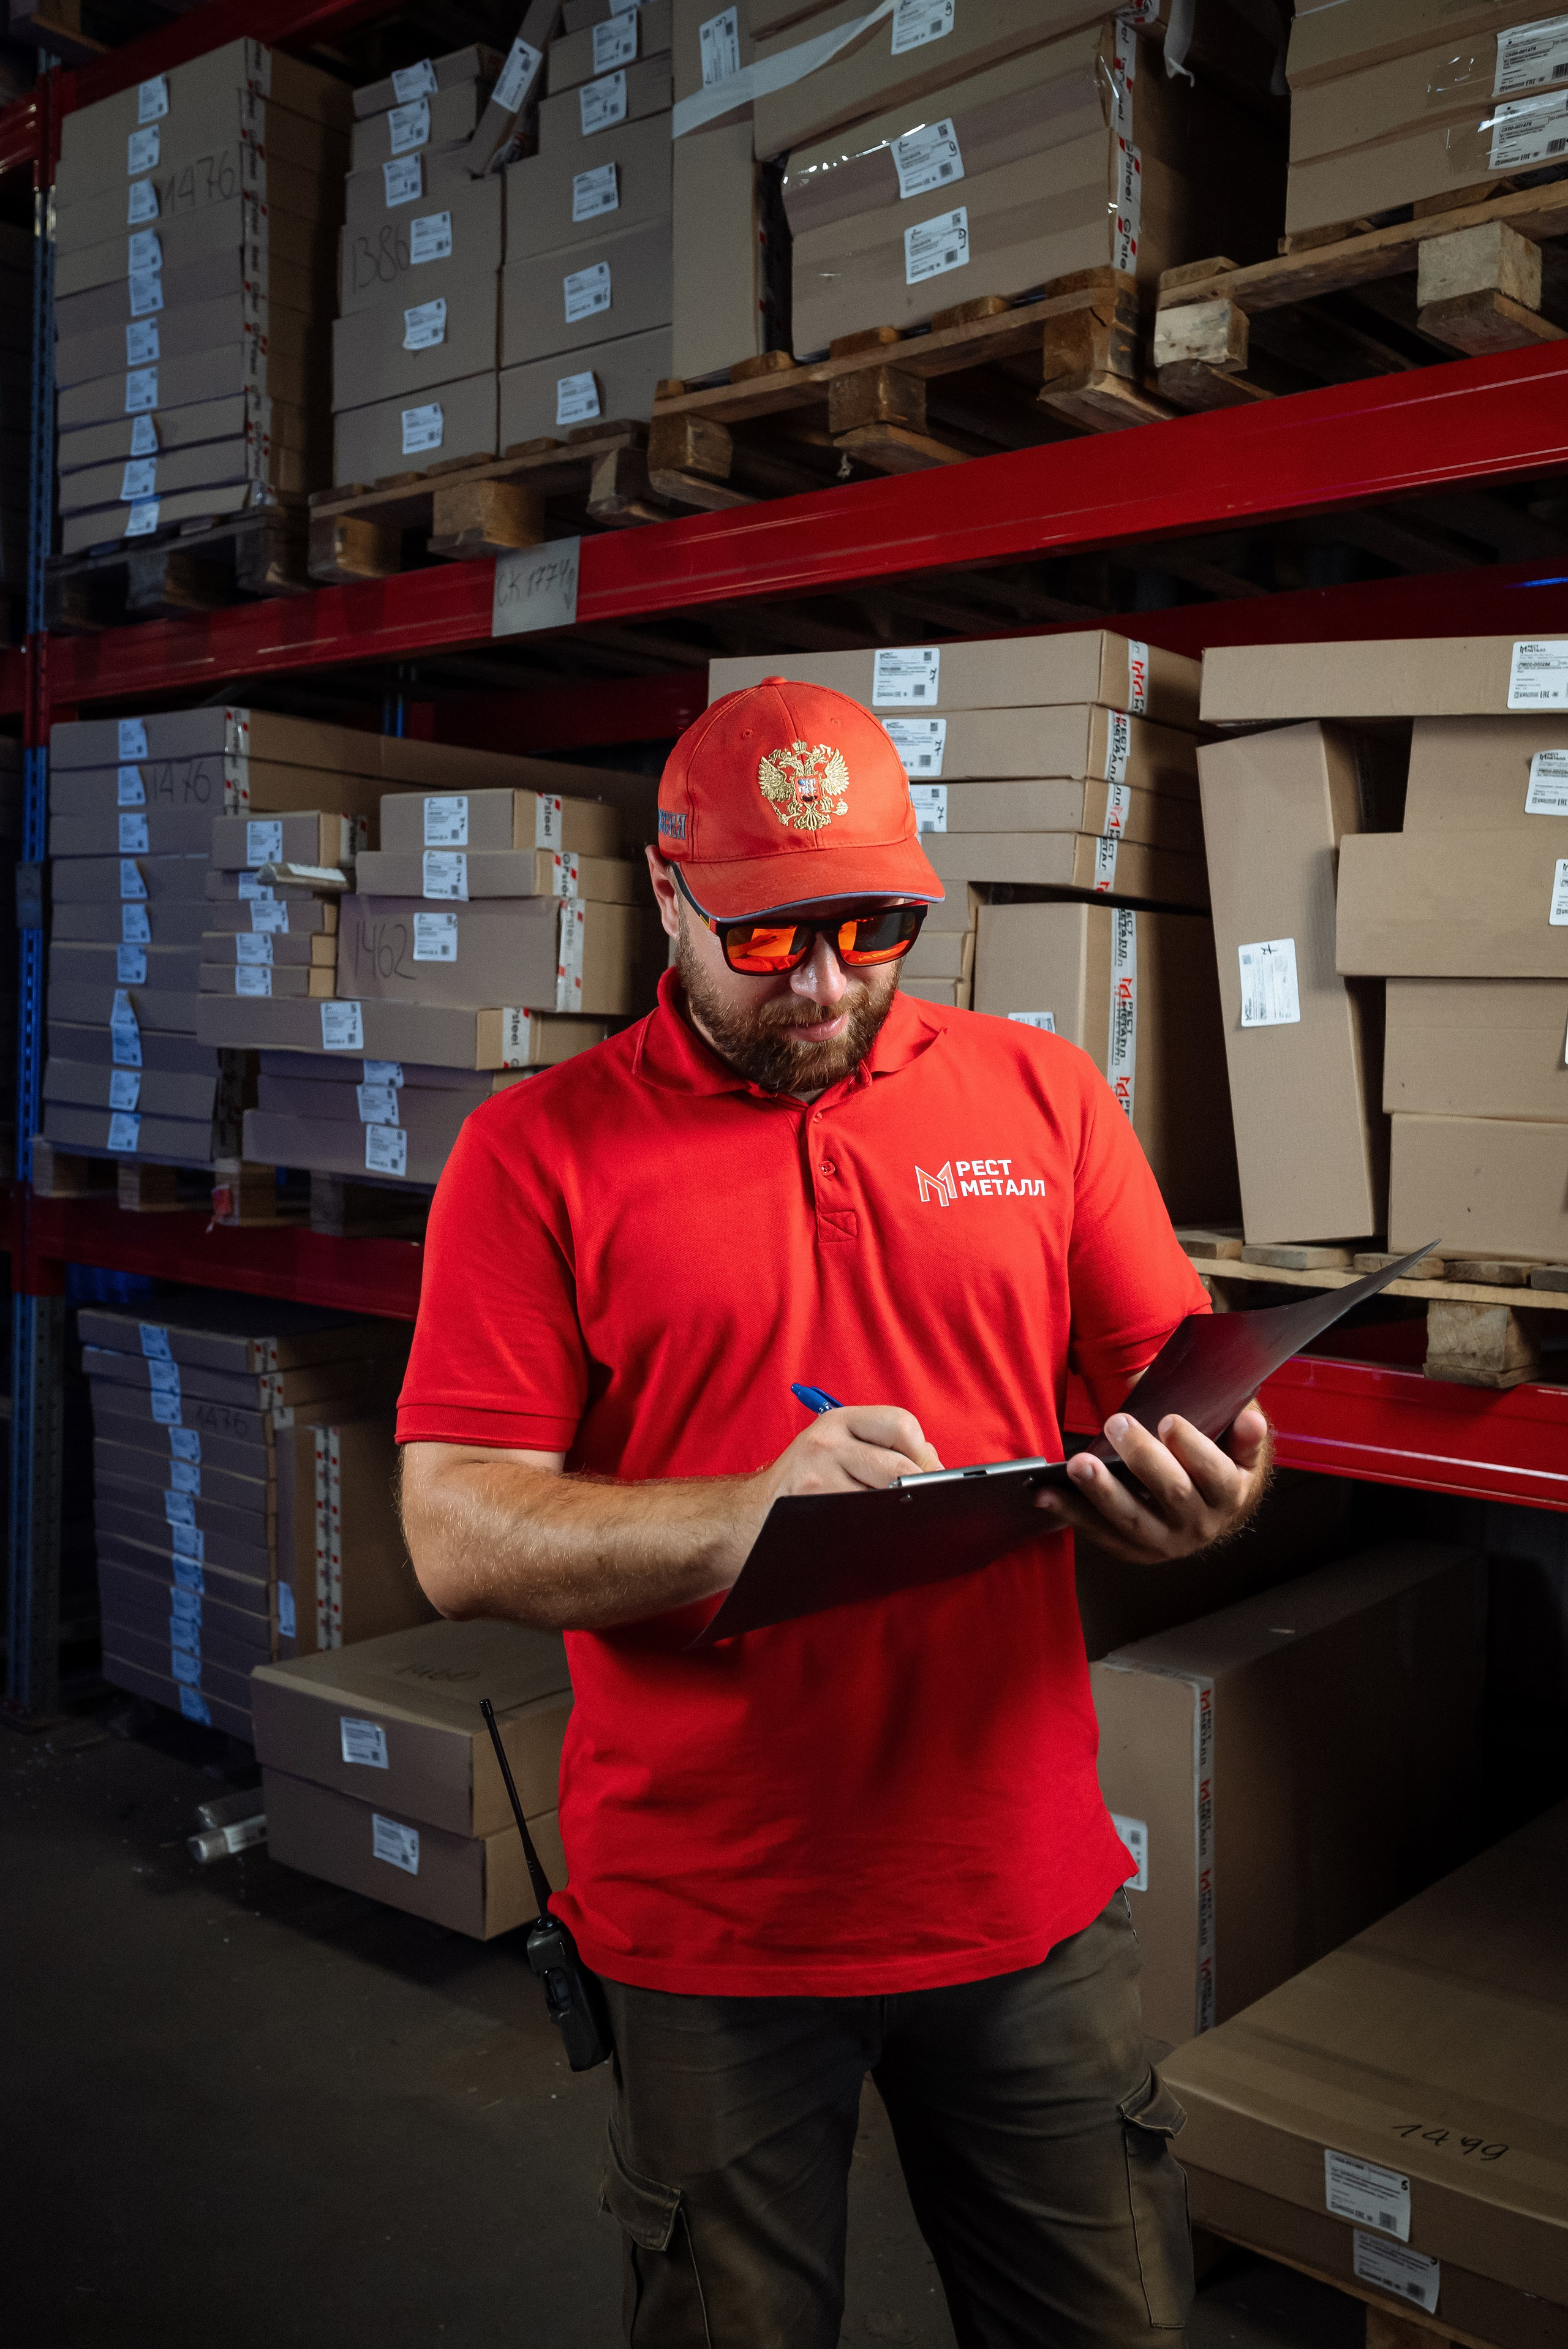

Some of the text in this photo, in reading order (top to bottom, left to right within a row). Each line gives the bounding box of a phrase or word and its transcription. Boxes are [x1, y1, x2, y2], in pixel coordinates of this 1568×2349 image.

[355, 920, 417, 981] 1462
[956, 1159, 1012, 1177] РЕСТ
[960, 1178, 1046, 1197] МЕТАЛЛ
[1392, 2124, 1509, 2161] 1499
